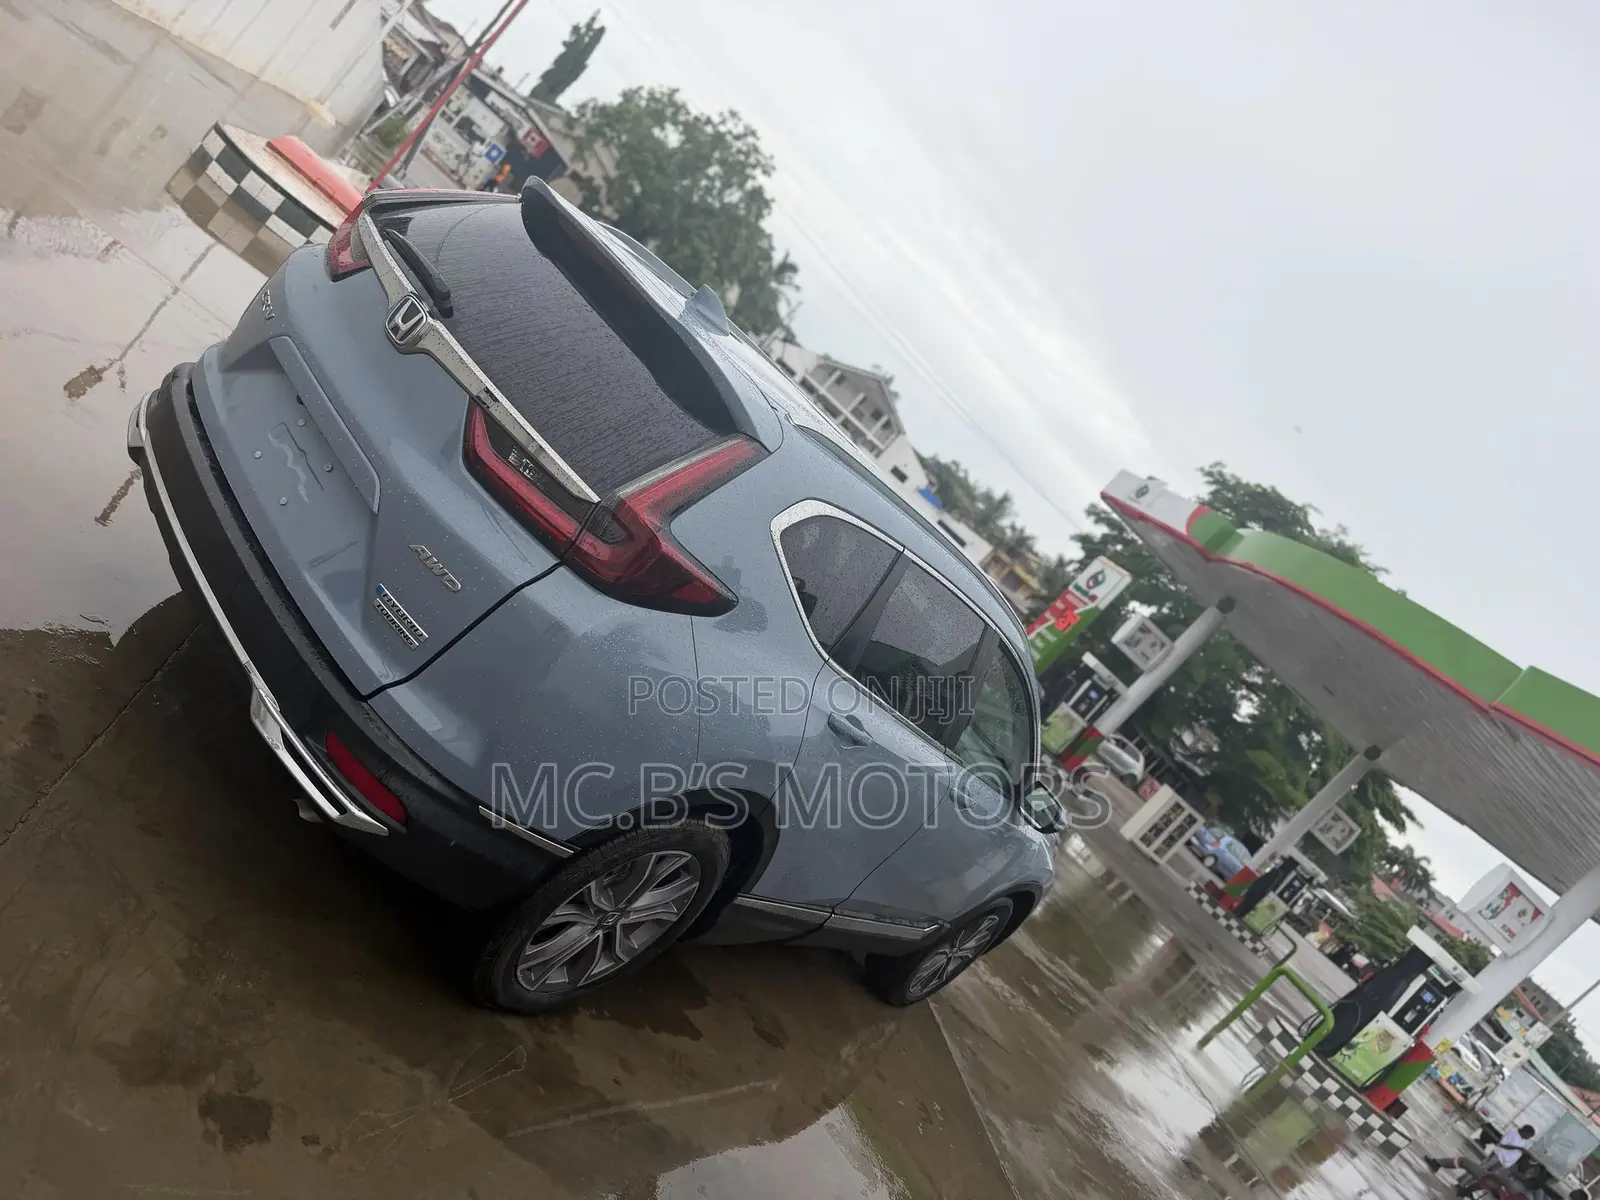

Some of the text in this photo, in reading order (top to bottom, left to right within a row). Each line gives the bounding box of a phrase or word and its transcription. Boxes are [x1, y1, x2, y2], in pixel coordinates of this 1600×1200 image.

[408, 544, 462, 593] AWD
[375, 601, 416, 647] TOURING
[381, 592, 425, 639] HYBRID
